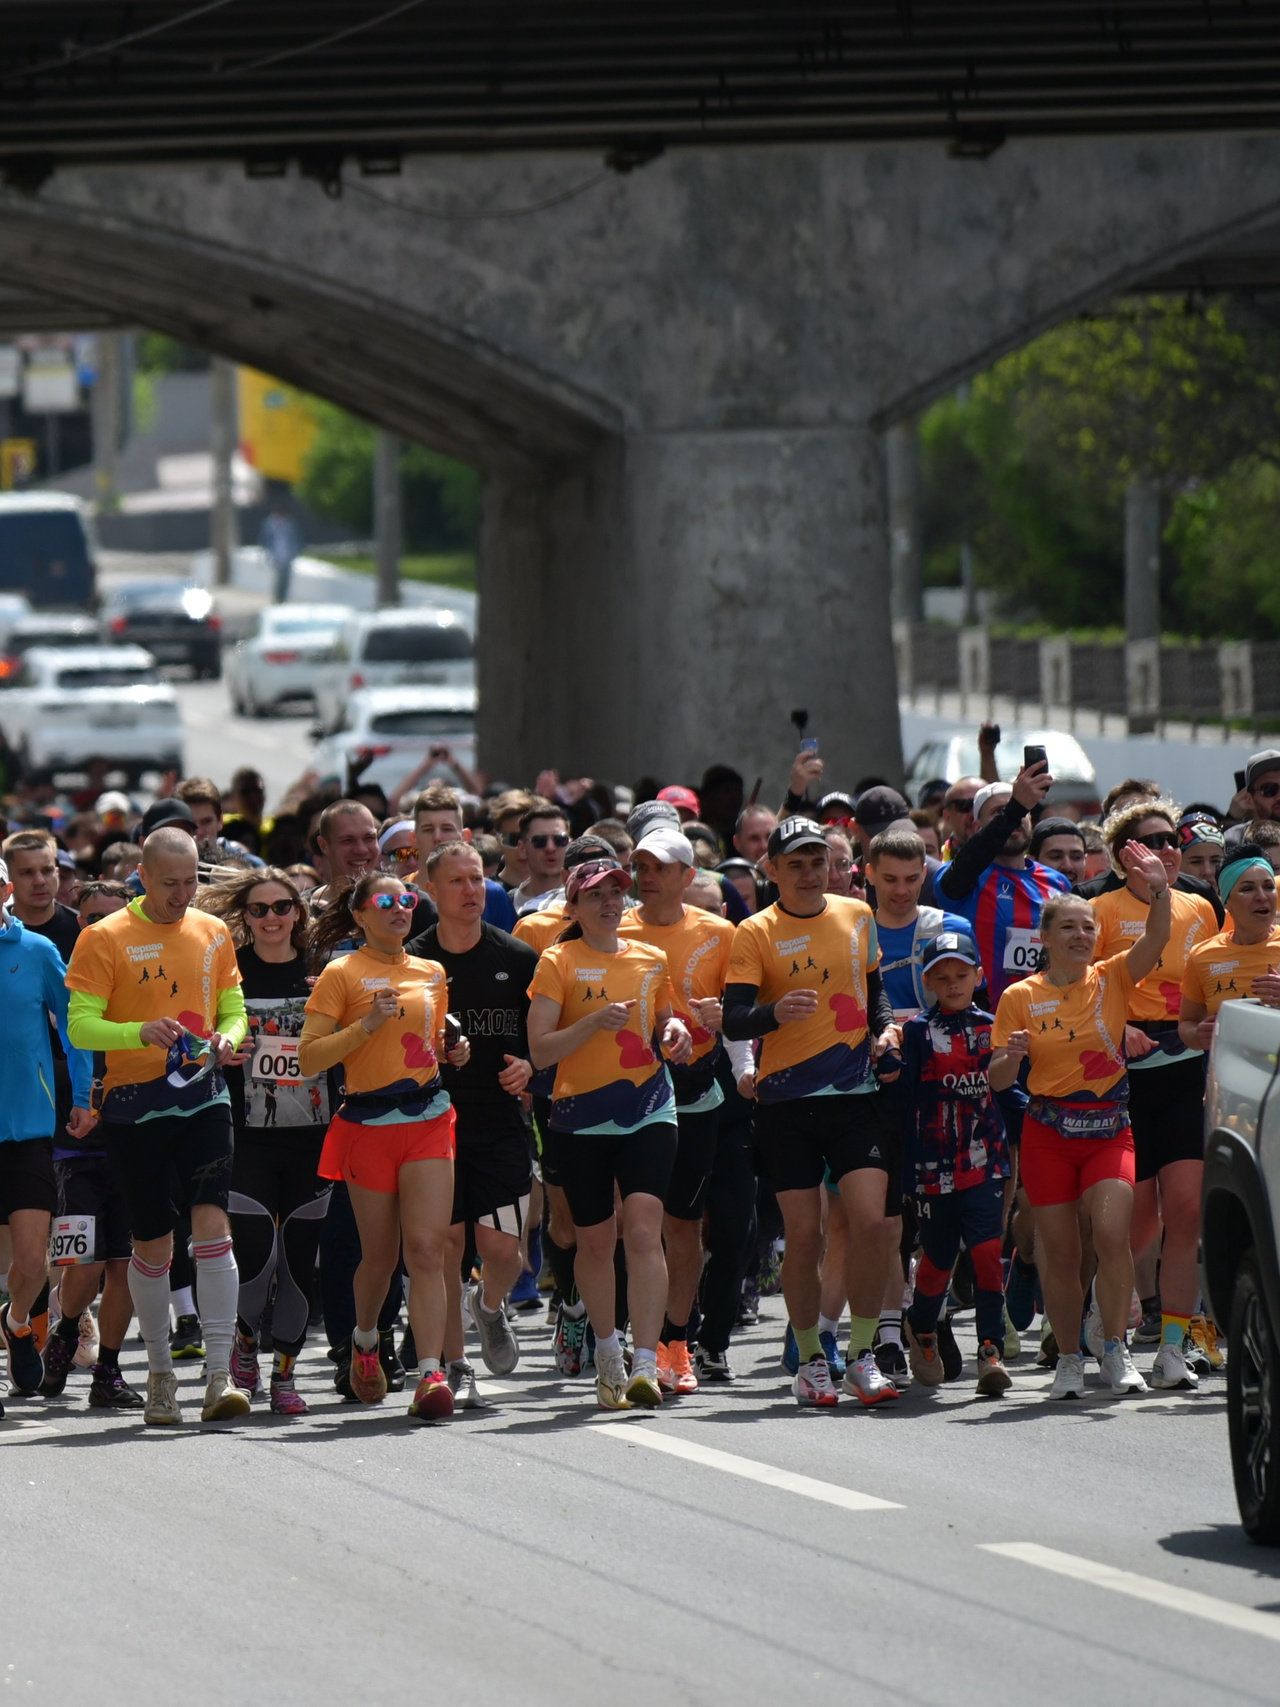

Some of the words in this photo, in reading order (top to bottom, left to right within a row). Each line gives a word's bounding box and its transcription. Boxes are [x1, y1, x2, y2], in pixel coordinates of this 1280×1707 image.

[780, 817, 822, 841] UFC
[126, 943, 163, 955] Первая
[129, 951, 159, 963] линия
[468, 1007, 519, 1036] MORE
[259, 1054, 301, 1078] 005
[942, 1071, 988, 1090] QATA
[1063, 1117, 1089, 1127] WAY
[1092, 1116, 1116, 1127] DAY
[916, 1200, 931, 1220] 14
[51, 1234, 87, 1258] 3976
